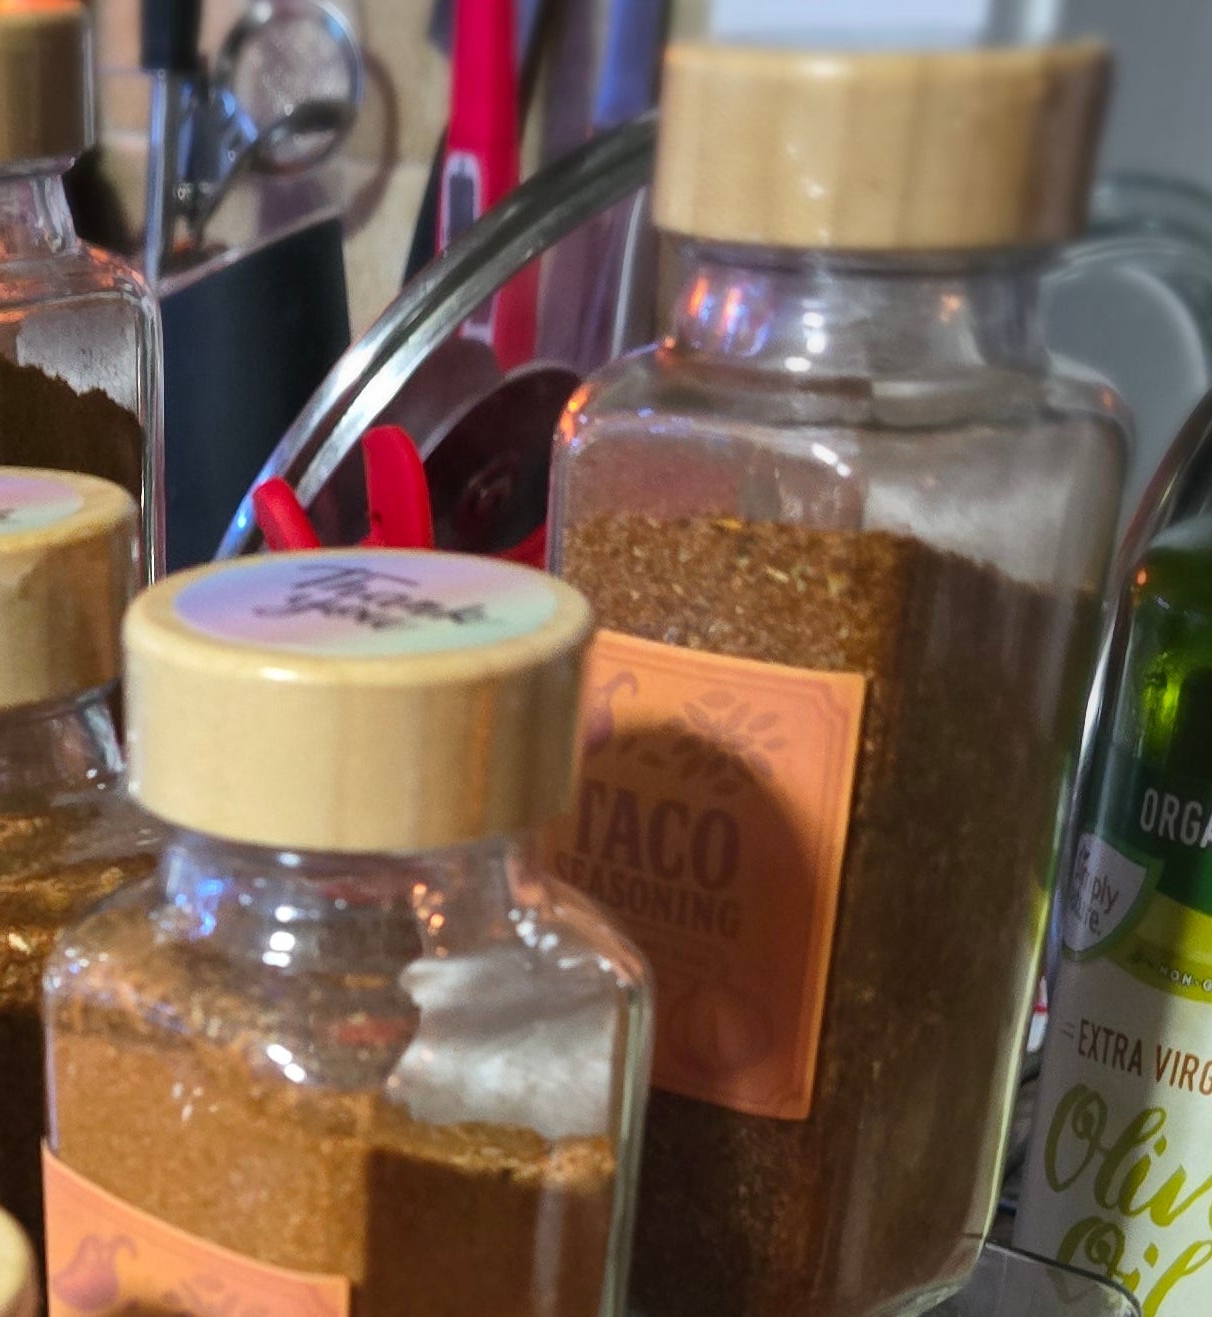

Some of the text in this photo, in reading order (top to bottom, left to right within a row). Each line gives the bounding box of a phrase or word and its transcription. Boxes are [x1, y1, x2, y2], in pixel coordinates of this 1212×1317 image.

[575, 779, 742, 891] TACO
[1078, 1017, 1143, 1077] EXTRA
[1045, 1083, 1212, 1228] Oliv
